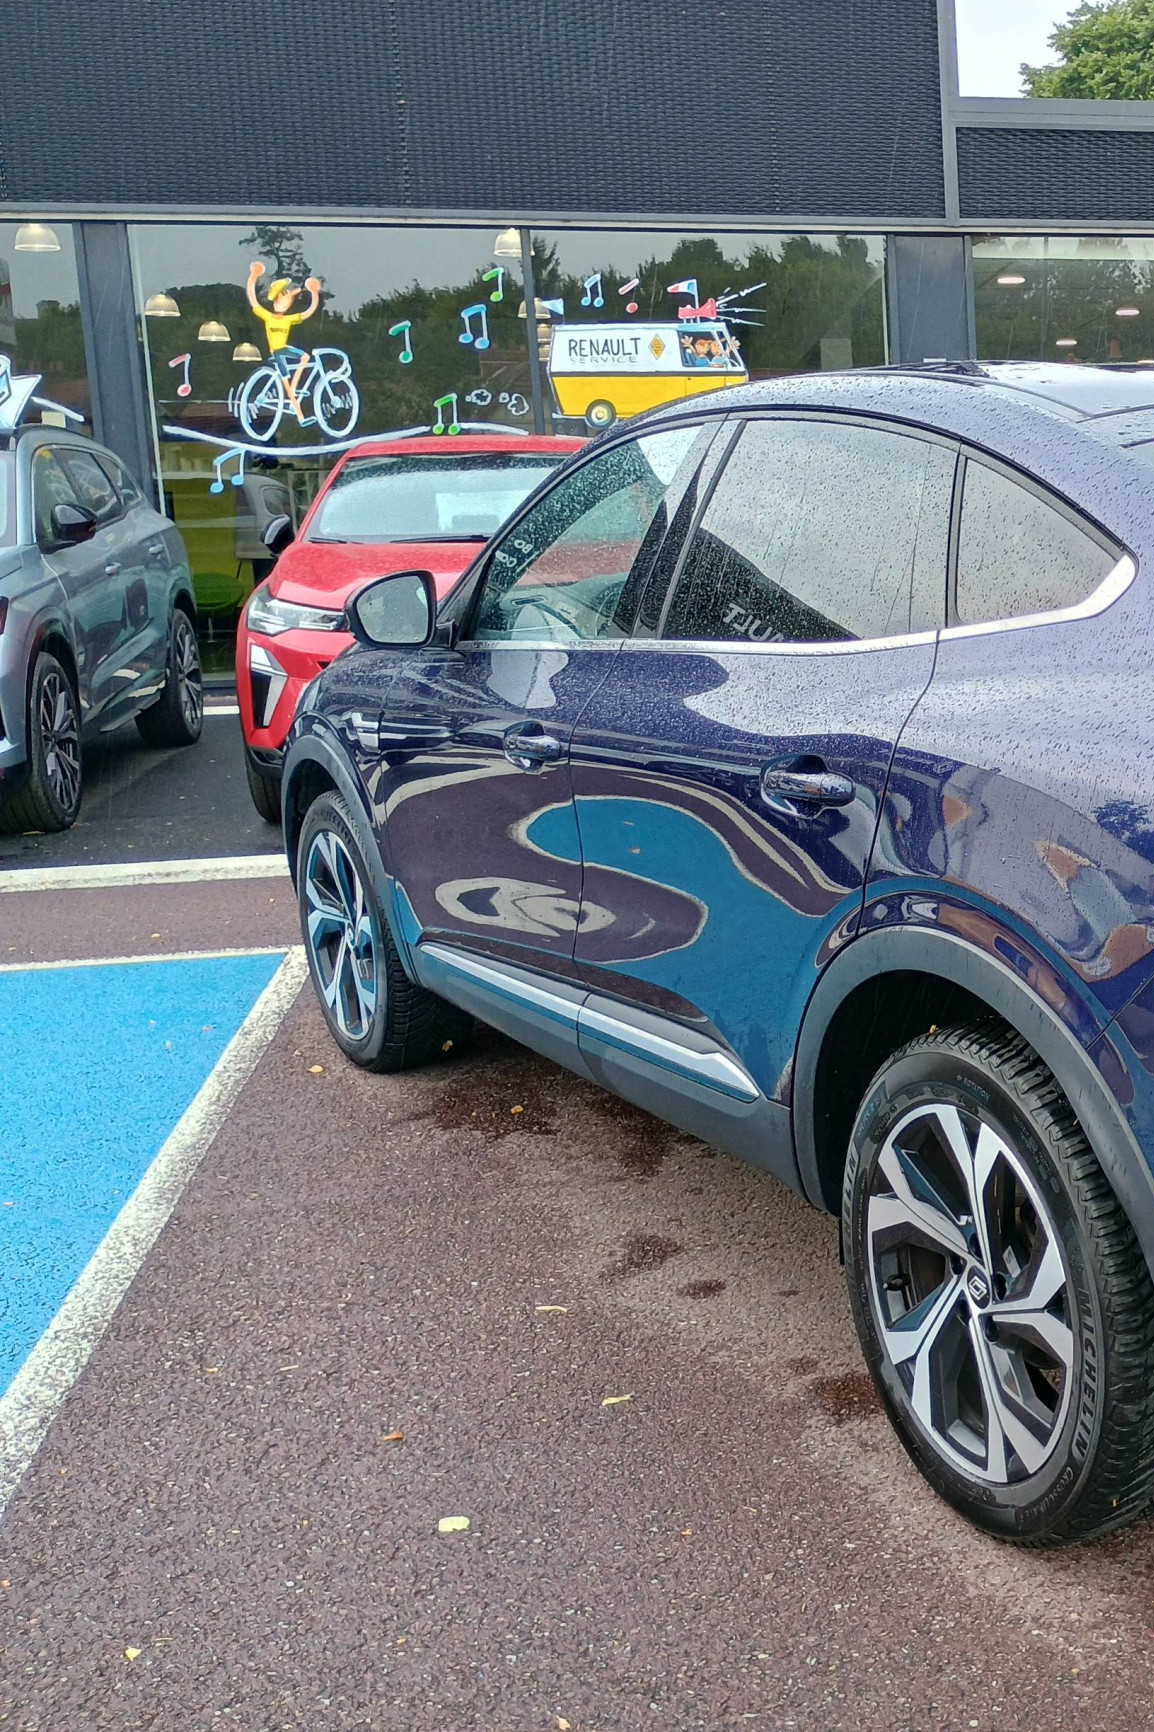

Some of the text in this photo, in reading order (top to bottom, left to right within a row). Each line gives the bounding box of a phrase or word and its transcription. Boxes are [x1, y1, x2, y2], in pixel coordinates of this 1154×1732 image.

[568, 337, 641, 357] RENAULT
[569, 356, 639, 364] SERVICE
[1075, 1288, 1097, 1460] MICHELIN
